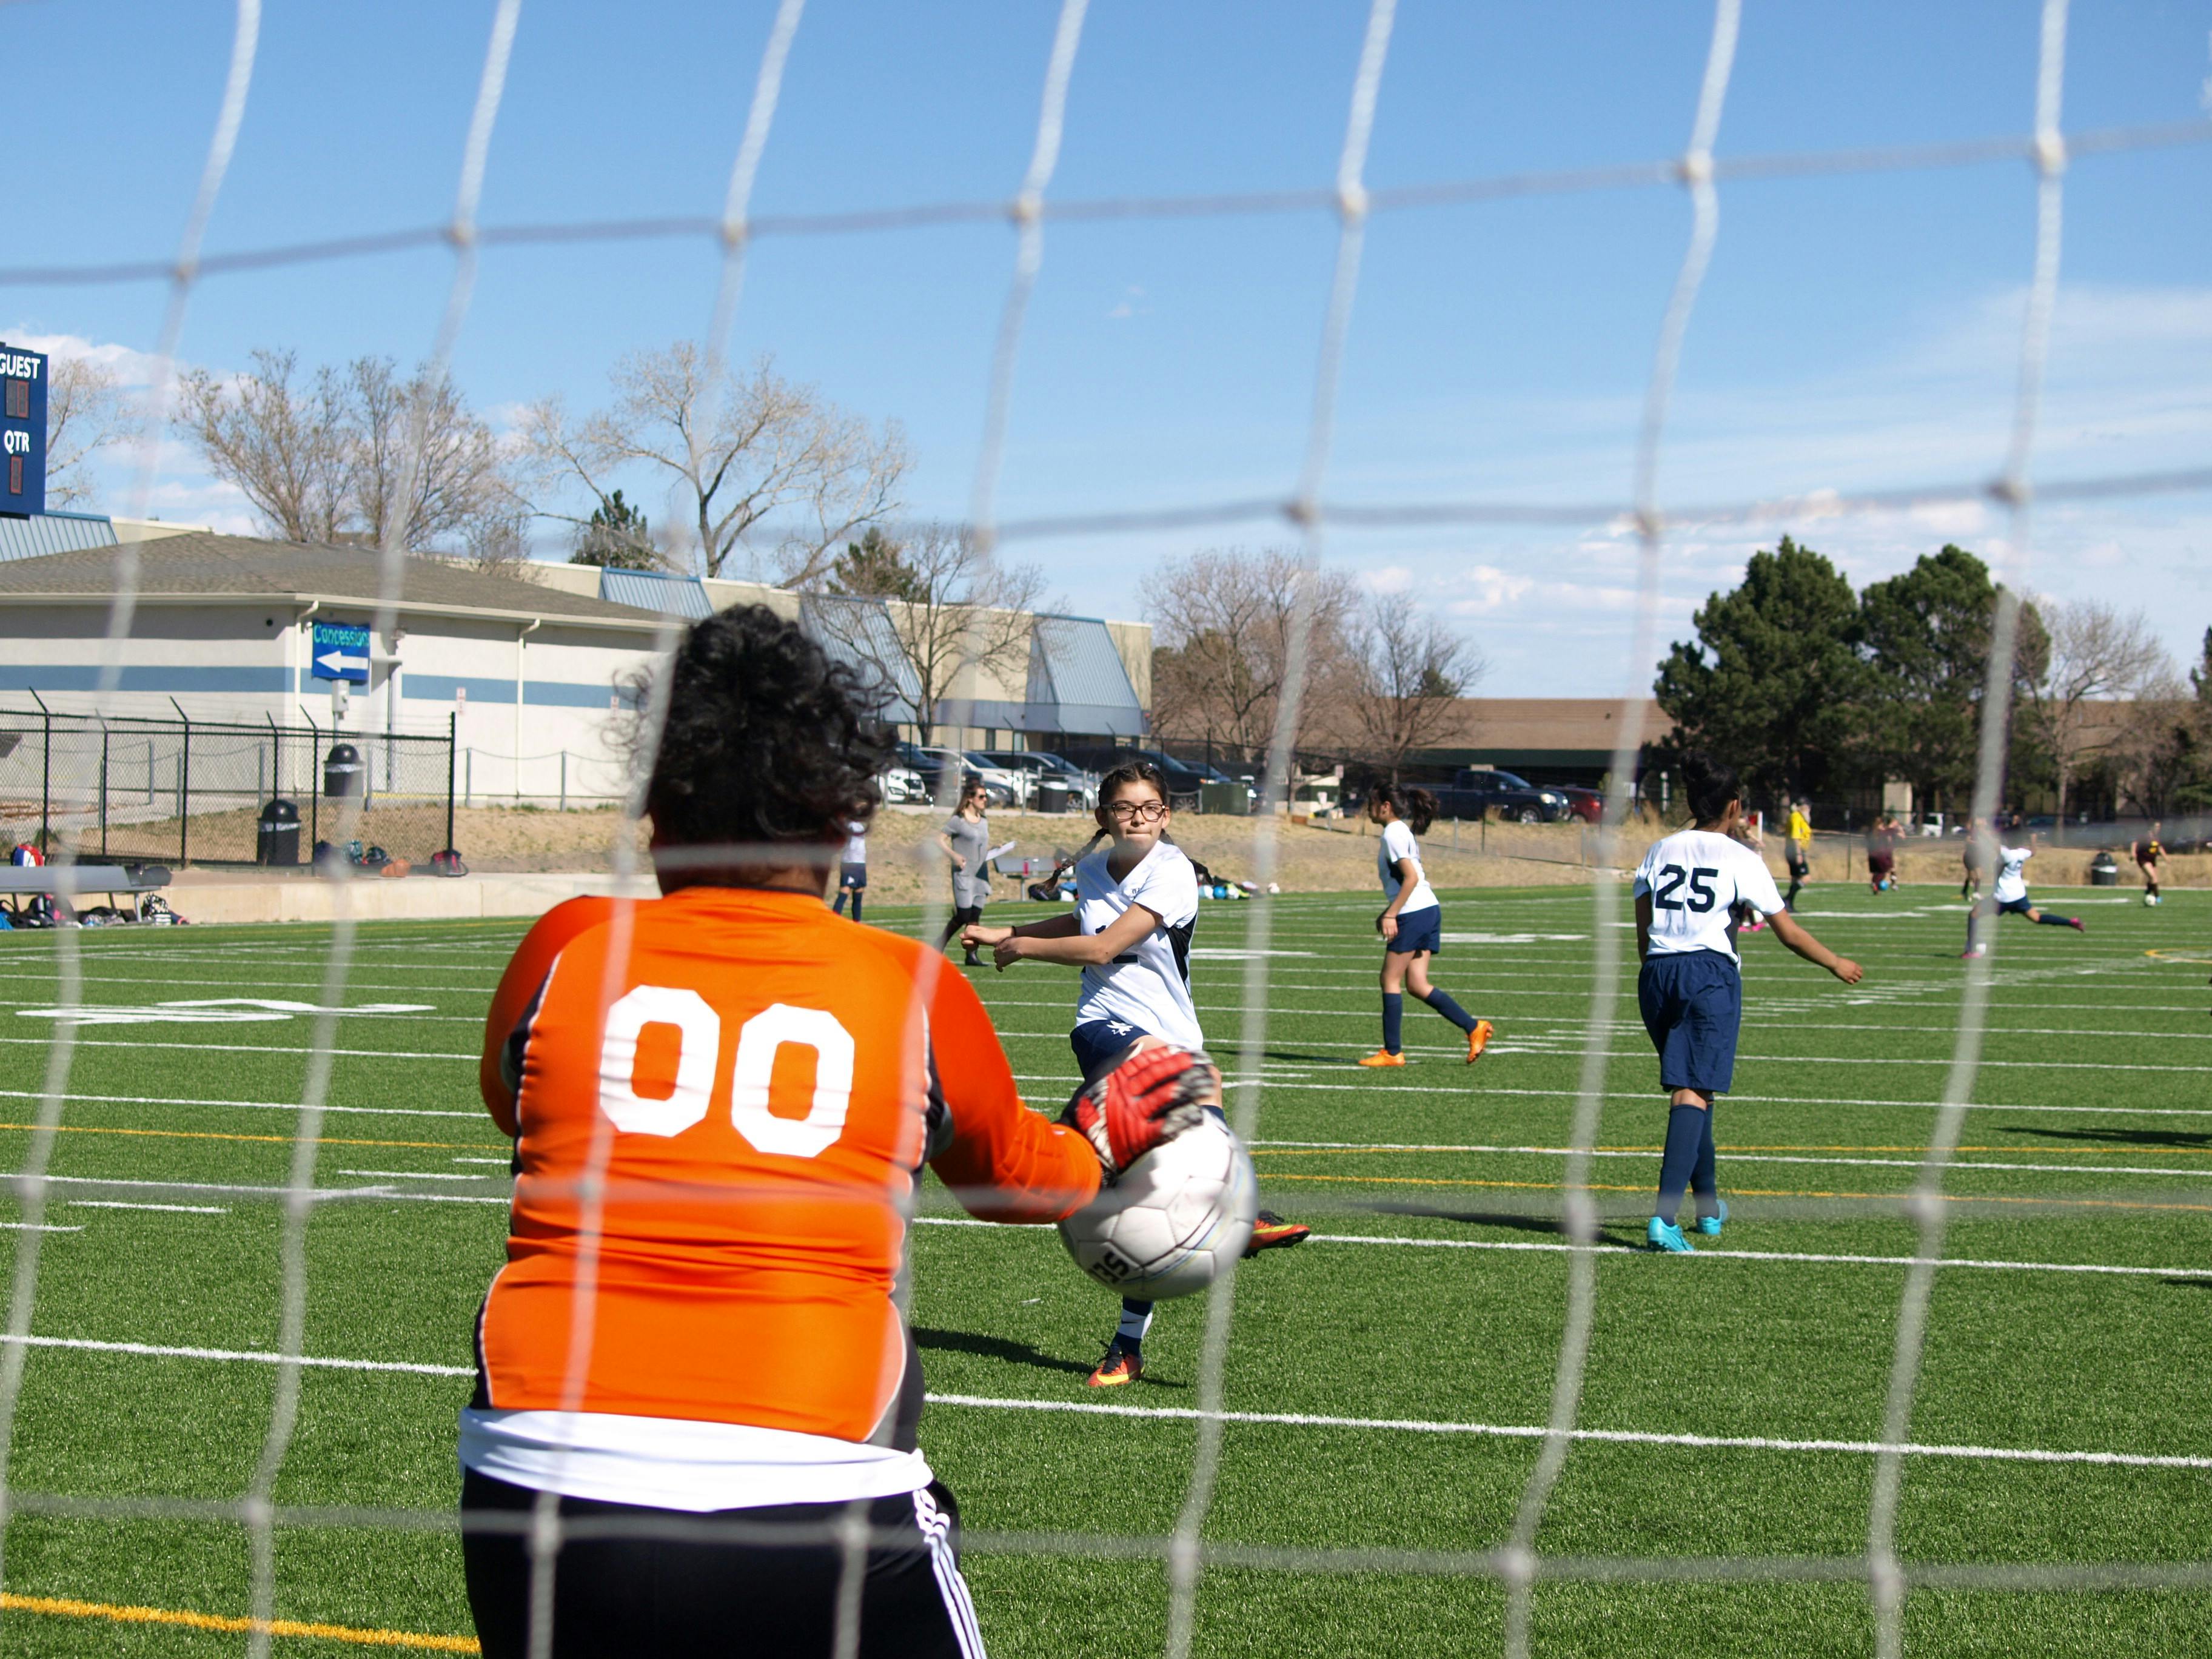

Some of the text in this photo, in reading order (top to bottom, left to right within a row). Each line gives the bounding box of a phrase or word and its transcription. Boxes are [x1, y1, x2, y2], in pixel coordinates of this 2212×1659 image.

[0, 353, 41, 379] GUEST
[4, 430, 29, 454] QTR
[1655, 863, 1718, 913] 25
[599, 984, 854, 1158] 00
